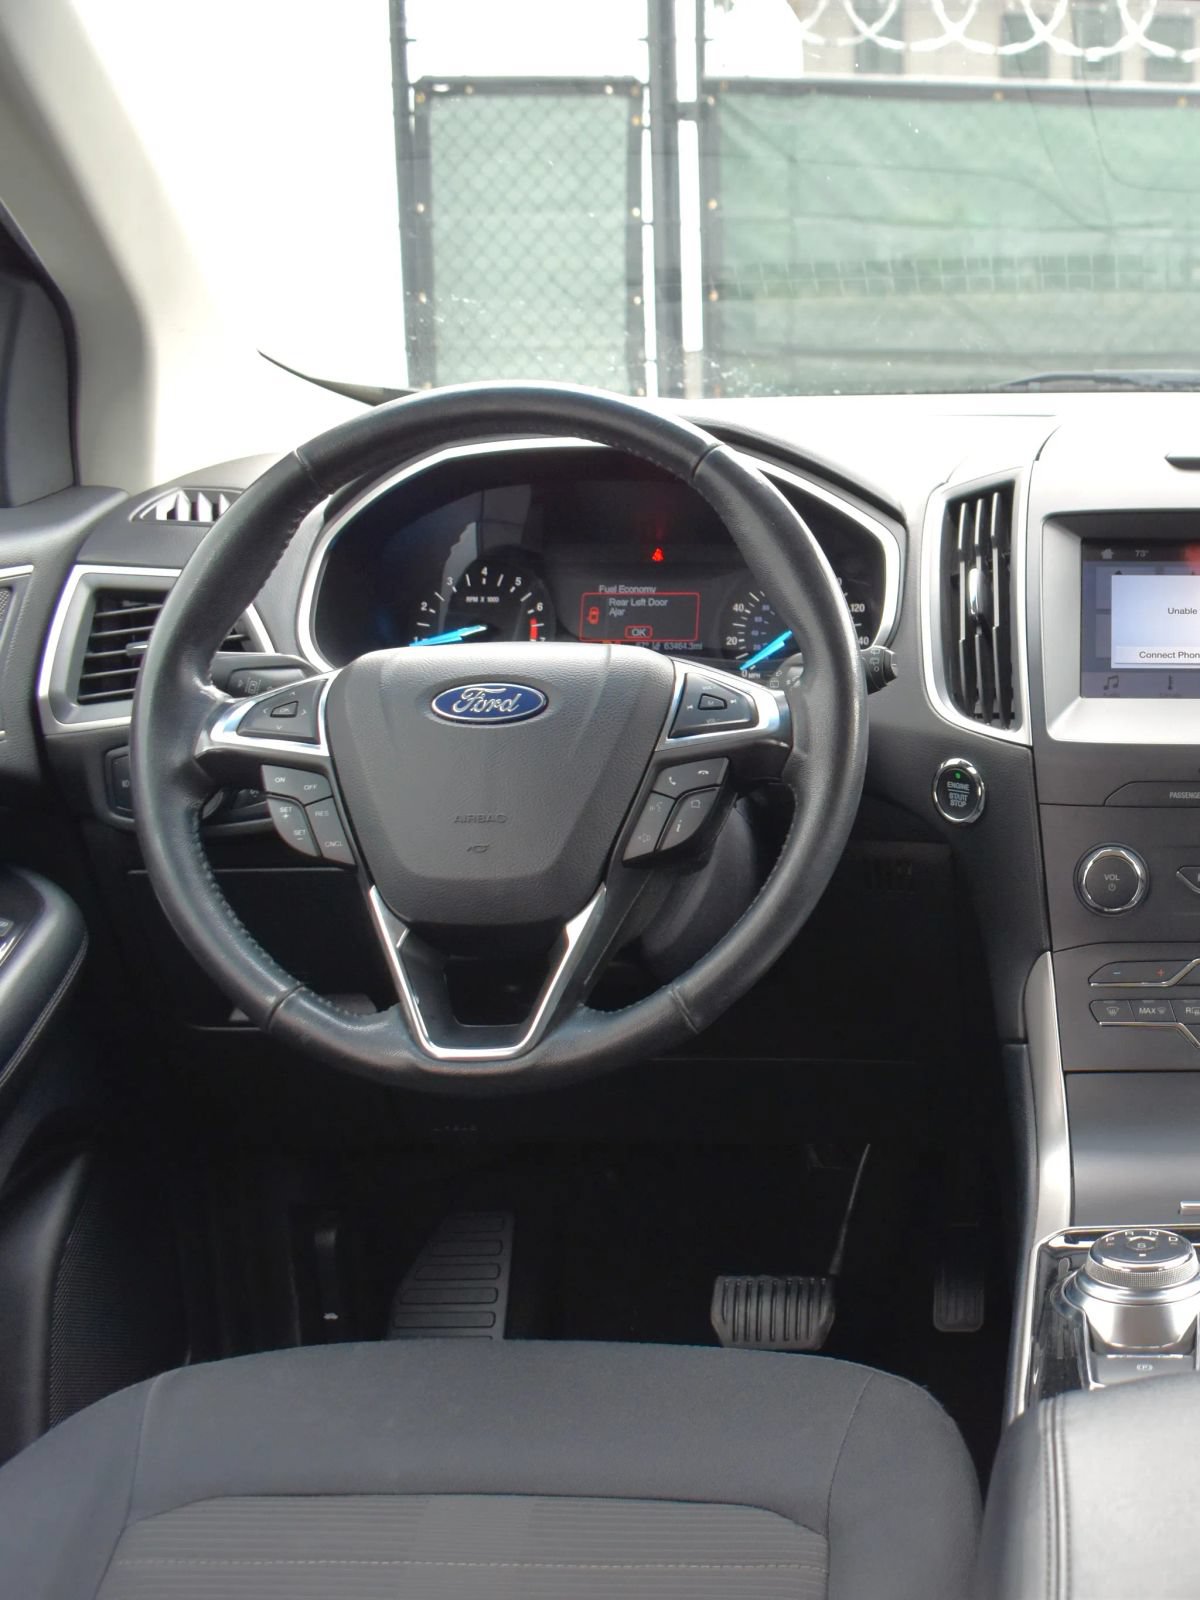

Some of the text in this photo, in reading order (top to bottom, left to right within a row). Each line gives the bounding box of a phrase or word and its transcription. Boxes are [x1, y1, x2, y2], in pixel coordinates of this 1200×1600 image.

[481, 566, 488, 577] 4
[446, 576, 454, 586] 3
[515, 576, 522, 586] 5
[598, 585, 657, 594] Fuel Economy
[421, 601, 428, 611] 2
[536, 602, 544, 612] 6
[608, 597, 668, 607] Rear Left Door
[609, 607, 626, 617] Ajar
[732, 603, 745, 613] 40
[850, 603, 865, 613] 120
[1167, 607, 1198, 615] Unable
[631, 628, 647, 637] OK
[726, 636, 738, 646] 20
[1139, 650, 1176, 659] Connect
[452, 687, 522, 713] Ford
[947, 781, 970, 790] ENGINE
[1103, 873, 1121, 881] VOL
